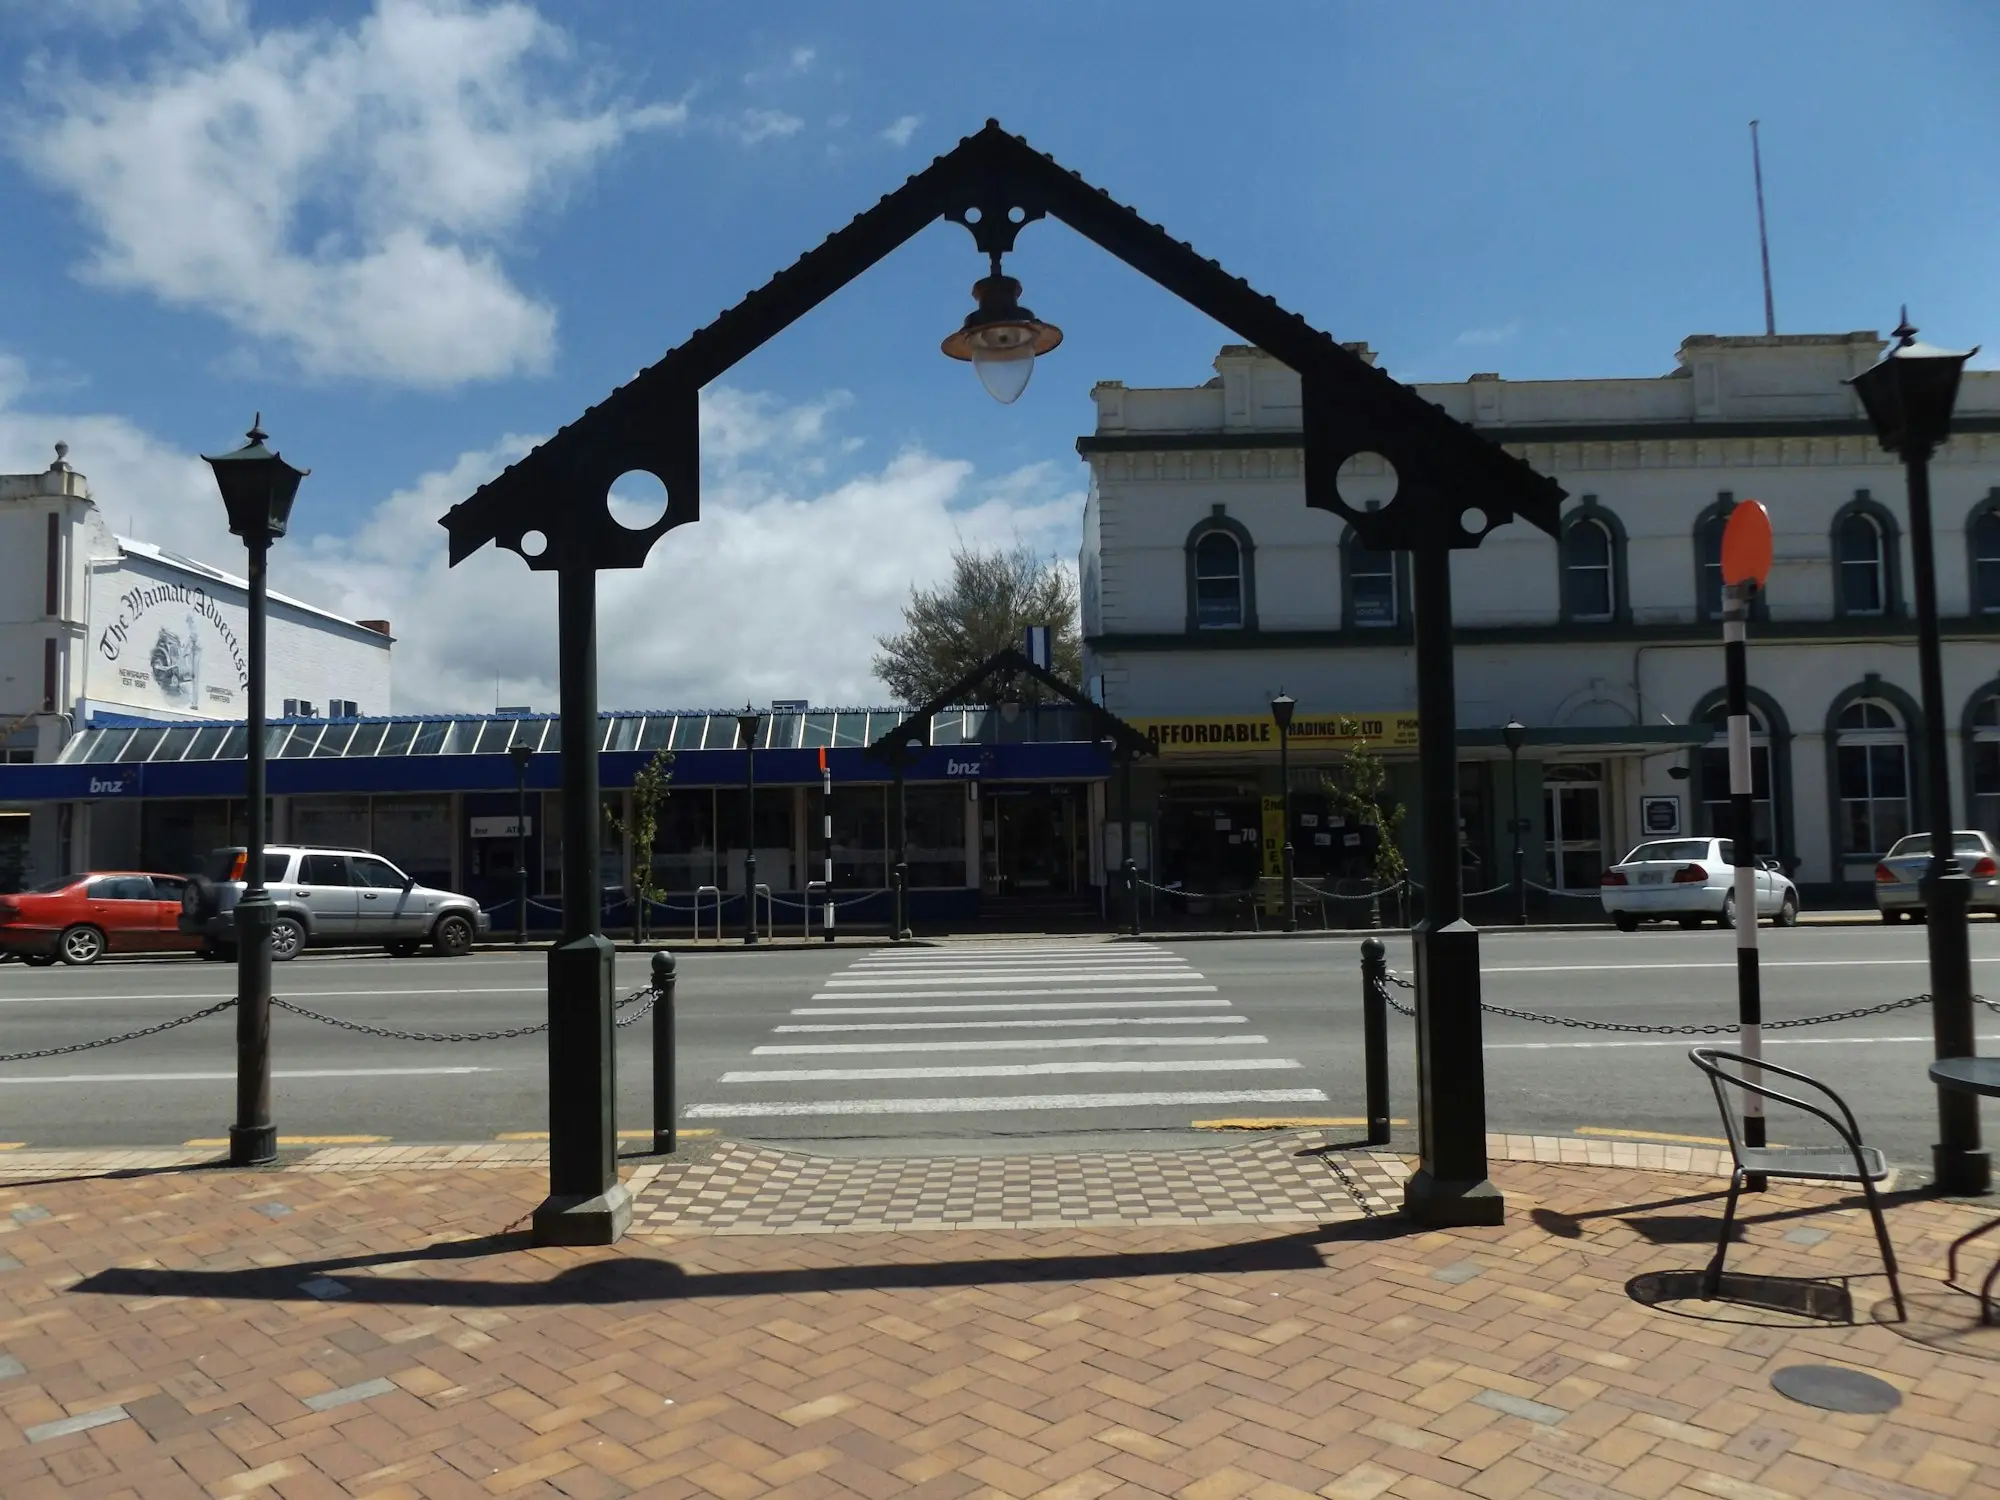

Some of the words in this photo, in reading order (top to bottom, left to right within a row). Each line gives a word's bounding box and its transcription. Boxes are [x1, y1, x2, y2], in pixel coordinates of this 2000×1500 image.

[99, 613, 129, 661] The
[120, 581, 191, 620] Waimate
[1148, 722, 1270, 744] AFFORDABLE
[1288, 721, 1335, 736] RADING
[1362, 720, 1383, 735] LTD
[1397, 719, 1419, 729] PHON
[946, 758, 981, 775] bnz
[89, 776, 123, 793] bnz
[1240, 827, 1257, 842] 70
